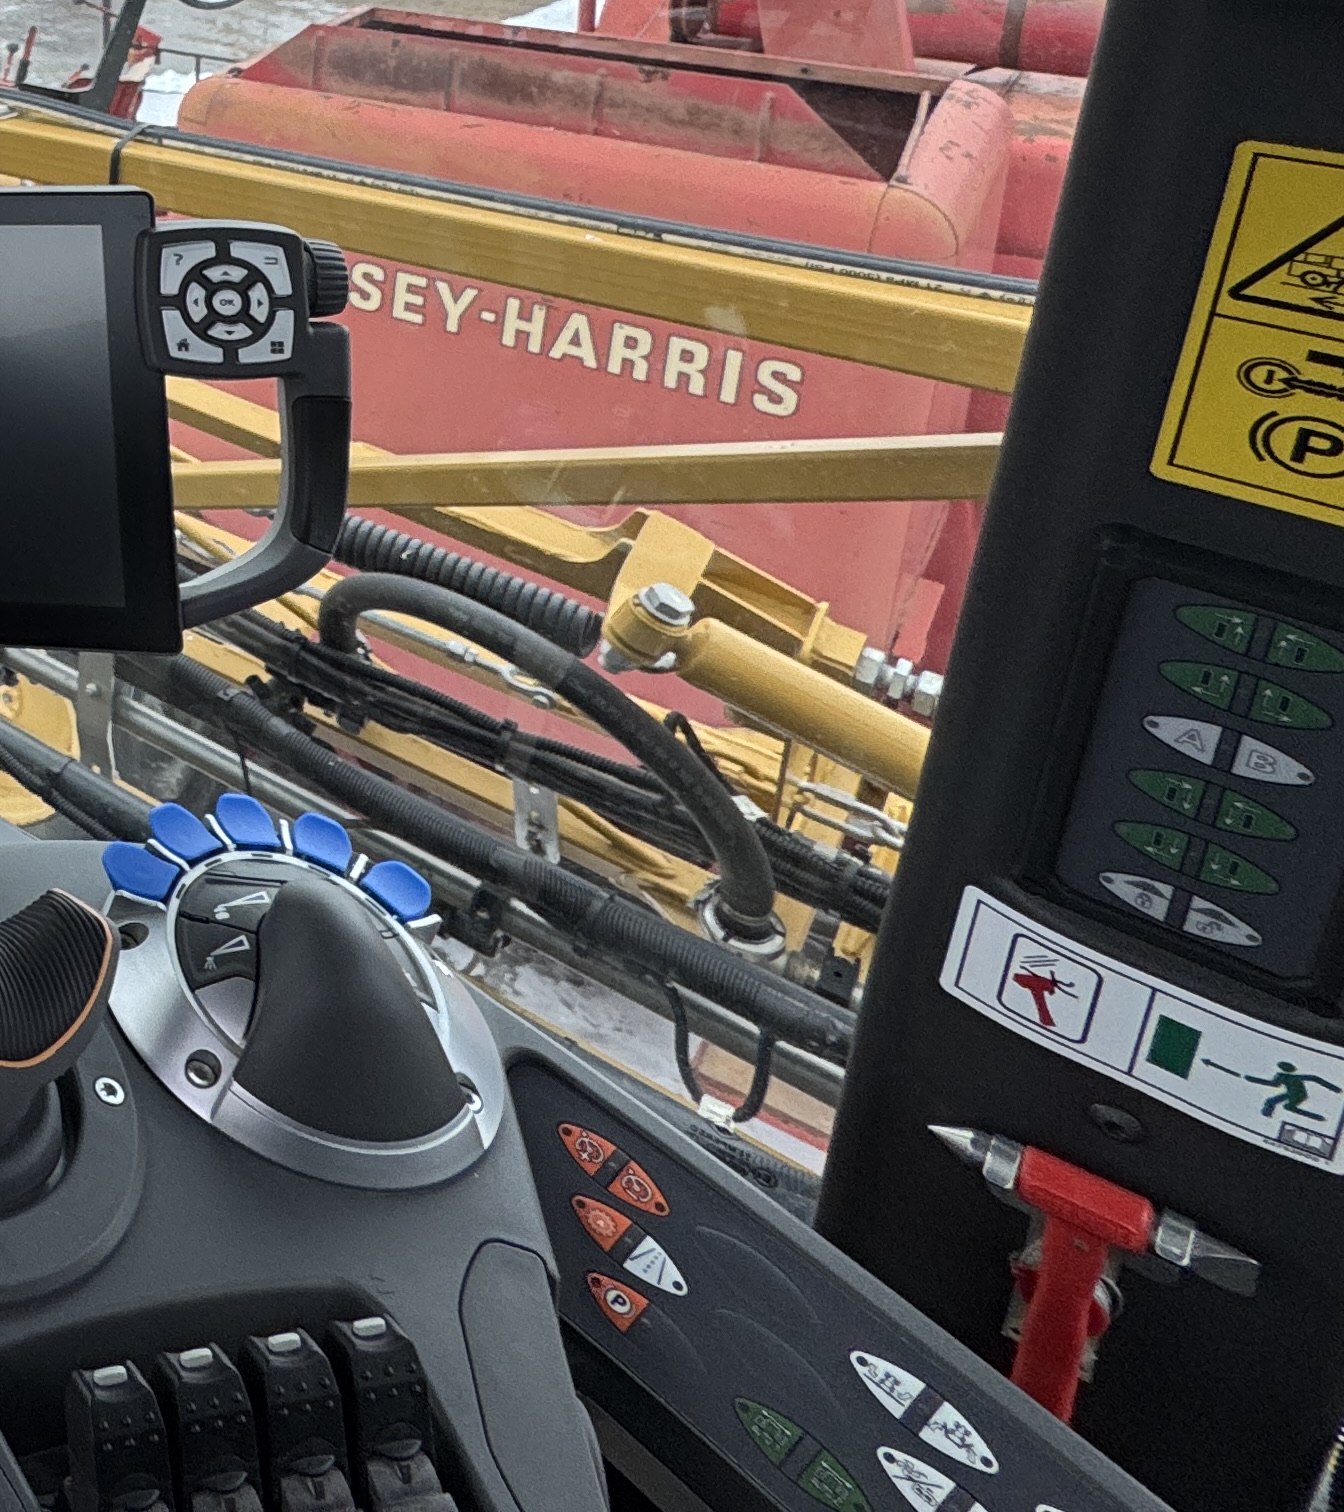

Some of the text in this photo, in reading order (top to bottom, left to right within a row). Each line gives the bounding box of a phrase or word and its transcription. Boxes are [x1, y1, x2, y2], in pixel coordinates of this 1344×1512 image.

[219, 297, 236, 307] OK
[1174, 728, 1207, 754] A
[1245, 749, 1278, 775] B
